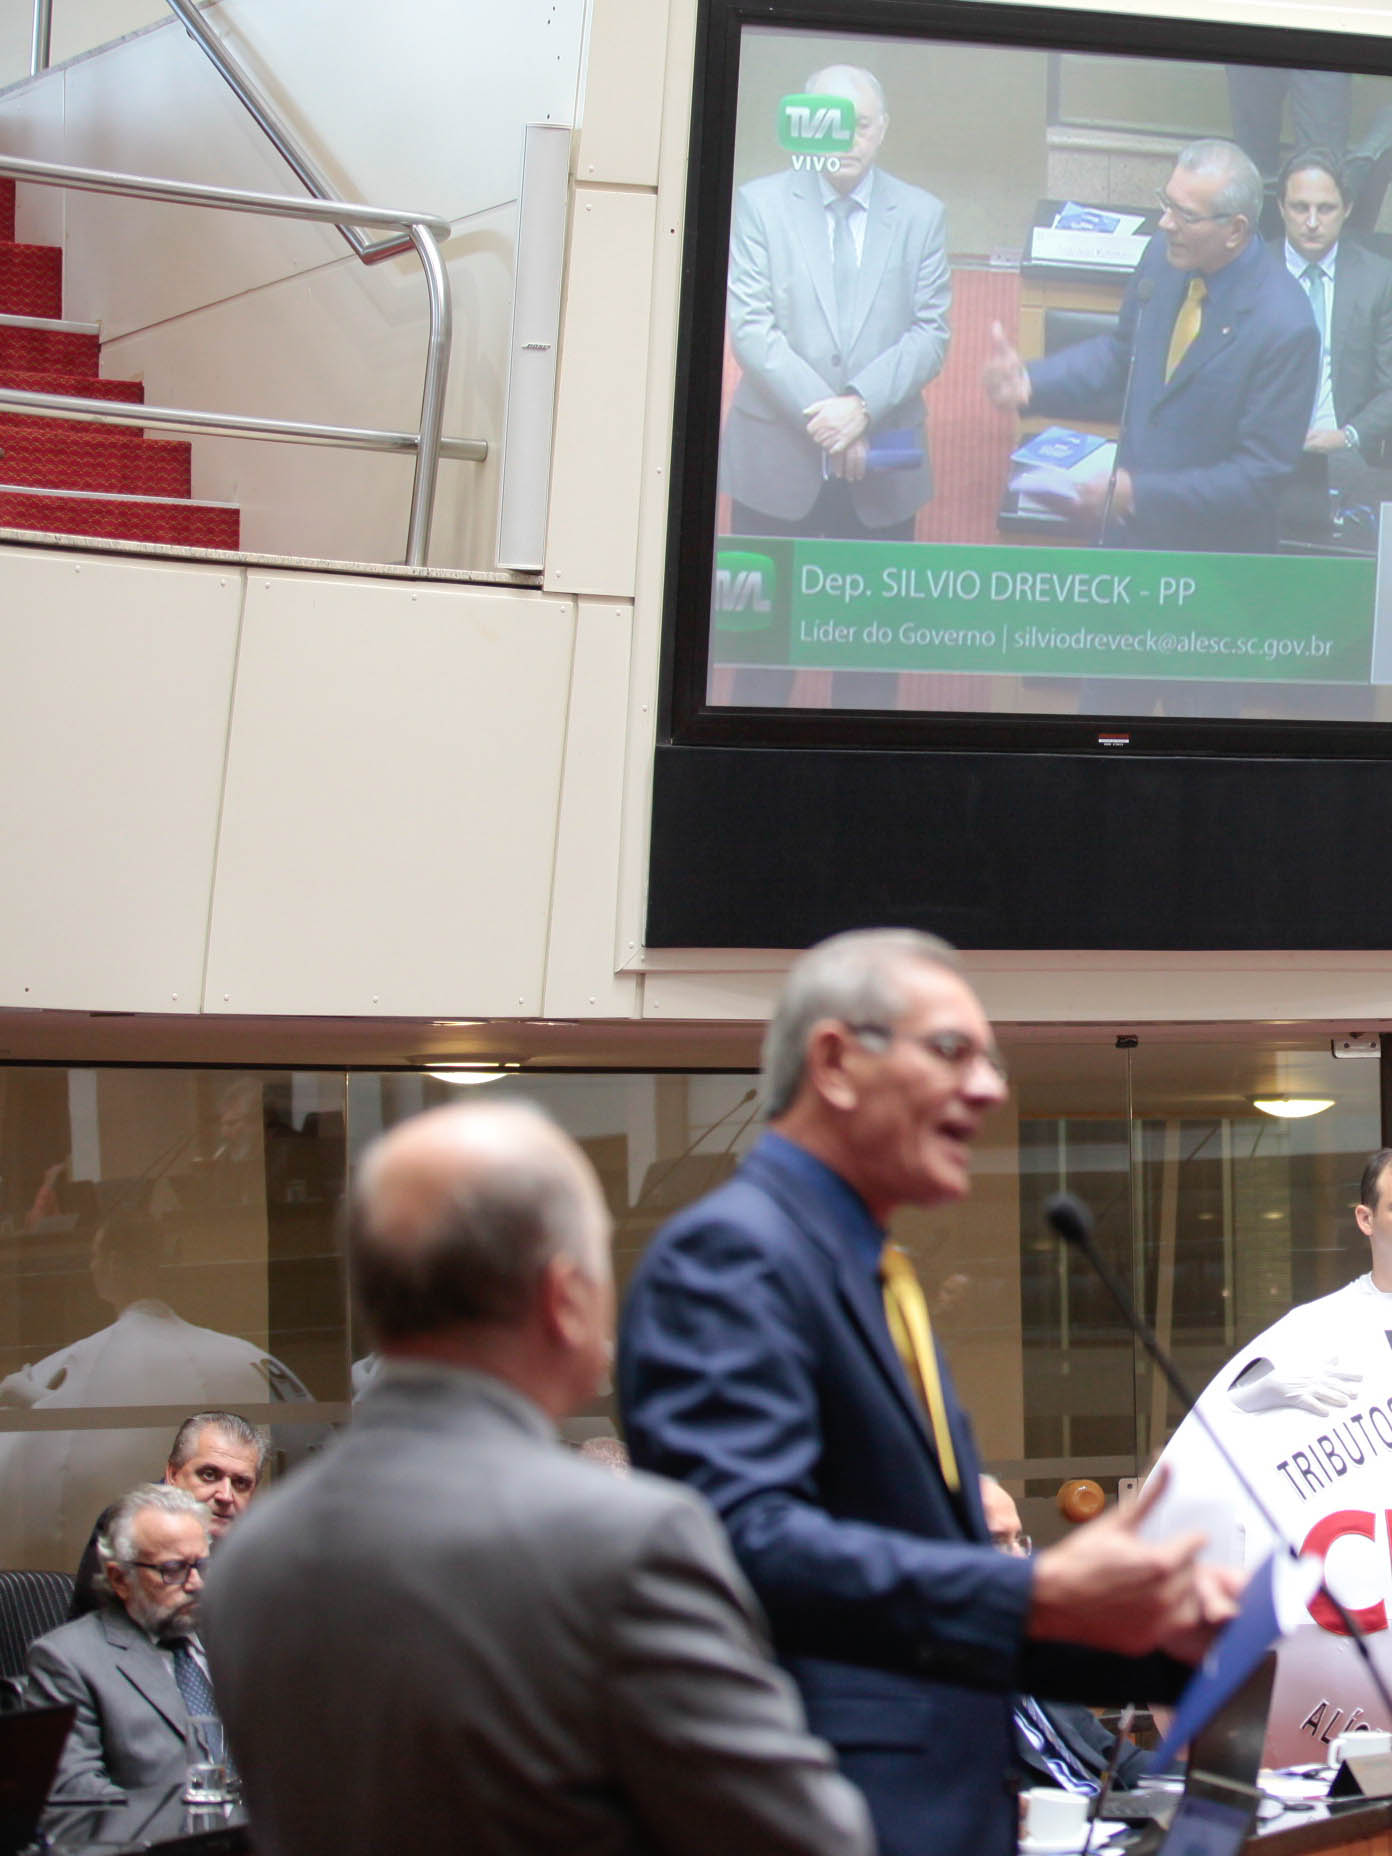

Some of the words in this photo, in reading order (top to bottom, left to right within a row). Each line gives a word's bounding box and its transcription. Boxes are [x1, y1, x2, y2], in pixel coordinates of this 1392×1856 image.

[792, 155, 840, 172] VIVO
[801, 565, 872, 603] Dep.
[882, 567, 981, 600] SILVIO
[991, 571, 1132, 605] DREVECK
[1159, 576, 1196, 606] PP
[863, 621, 892, 644] do
[899, 622, 996, 647] Governo
[1015, 625, 1333, 662] silviodreveck@alesc.sc.gov.br
